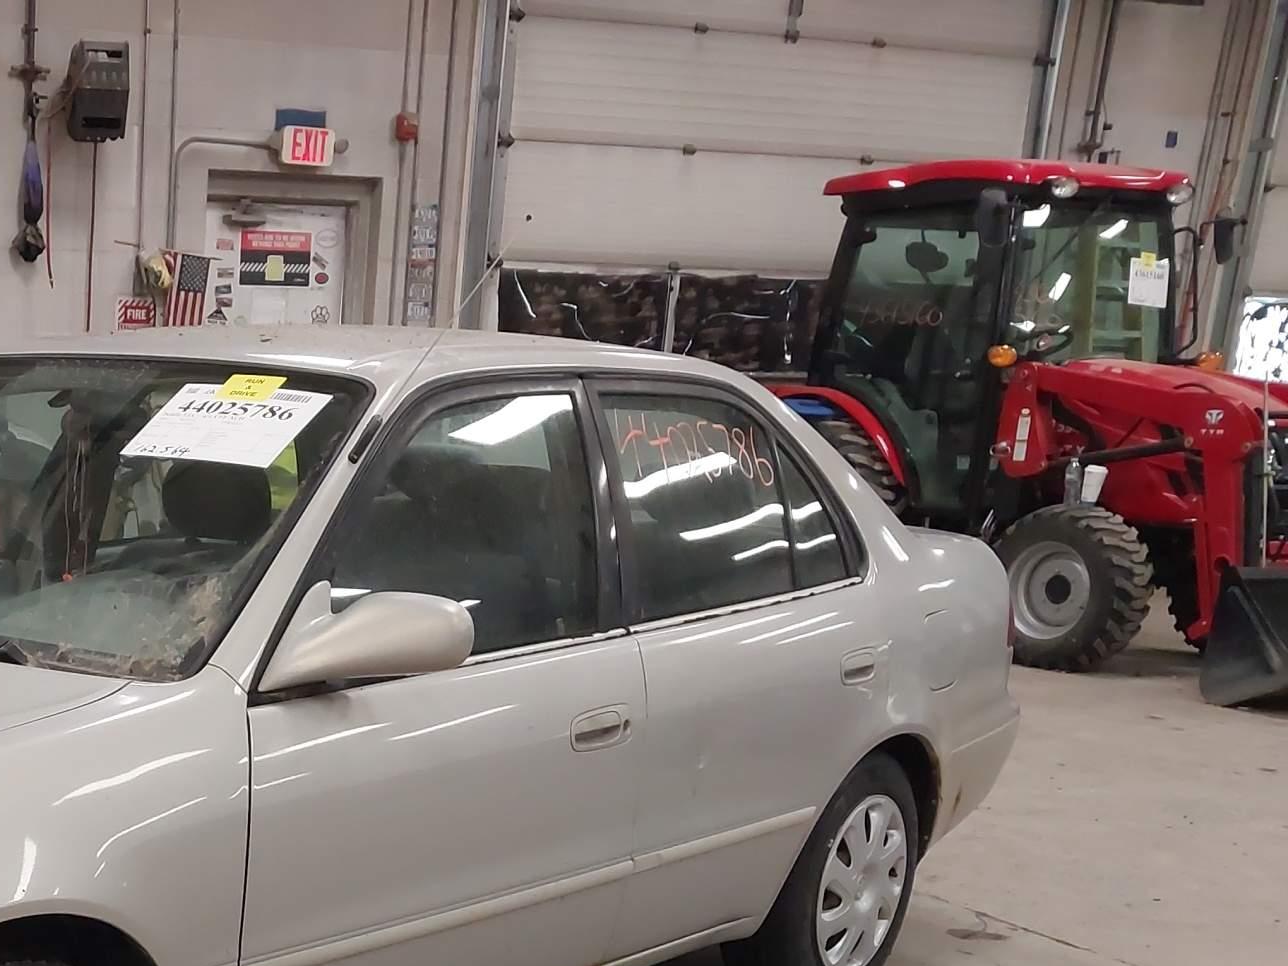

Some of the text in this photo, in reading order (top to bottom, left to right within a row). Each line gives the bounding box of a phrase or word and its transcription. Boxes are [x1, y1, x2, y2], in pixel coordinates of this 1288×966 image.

[291, 127, 329, 163] EXIT
[127, 308, 147, 320] FIRE
[178, 399, 299, 421] 44025786
